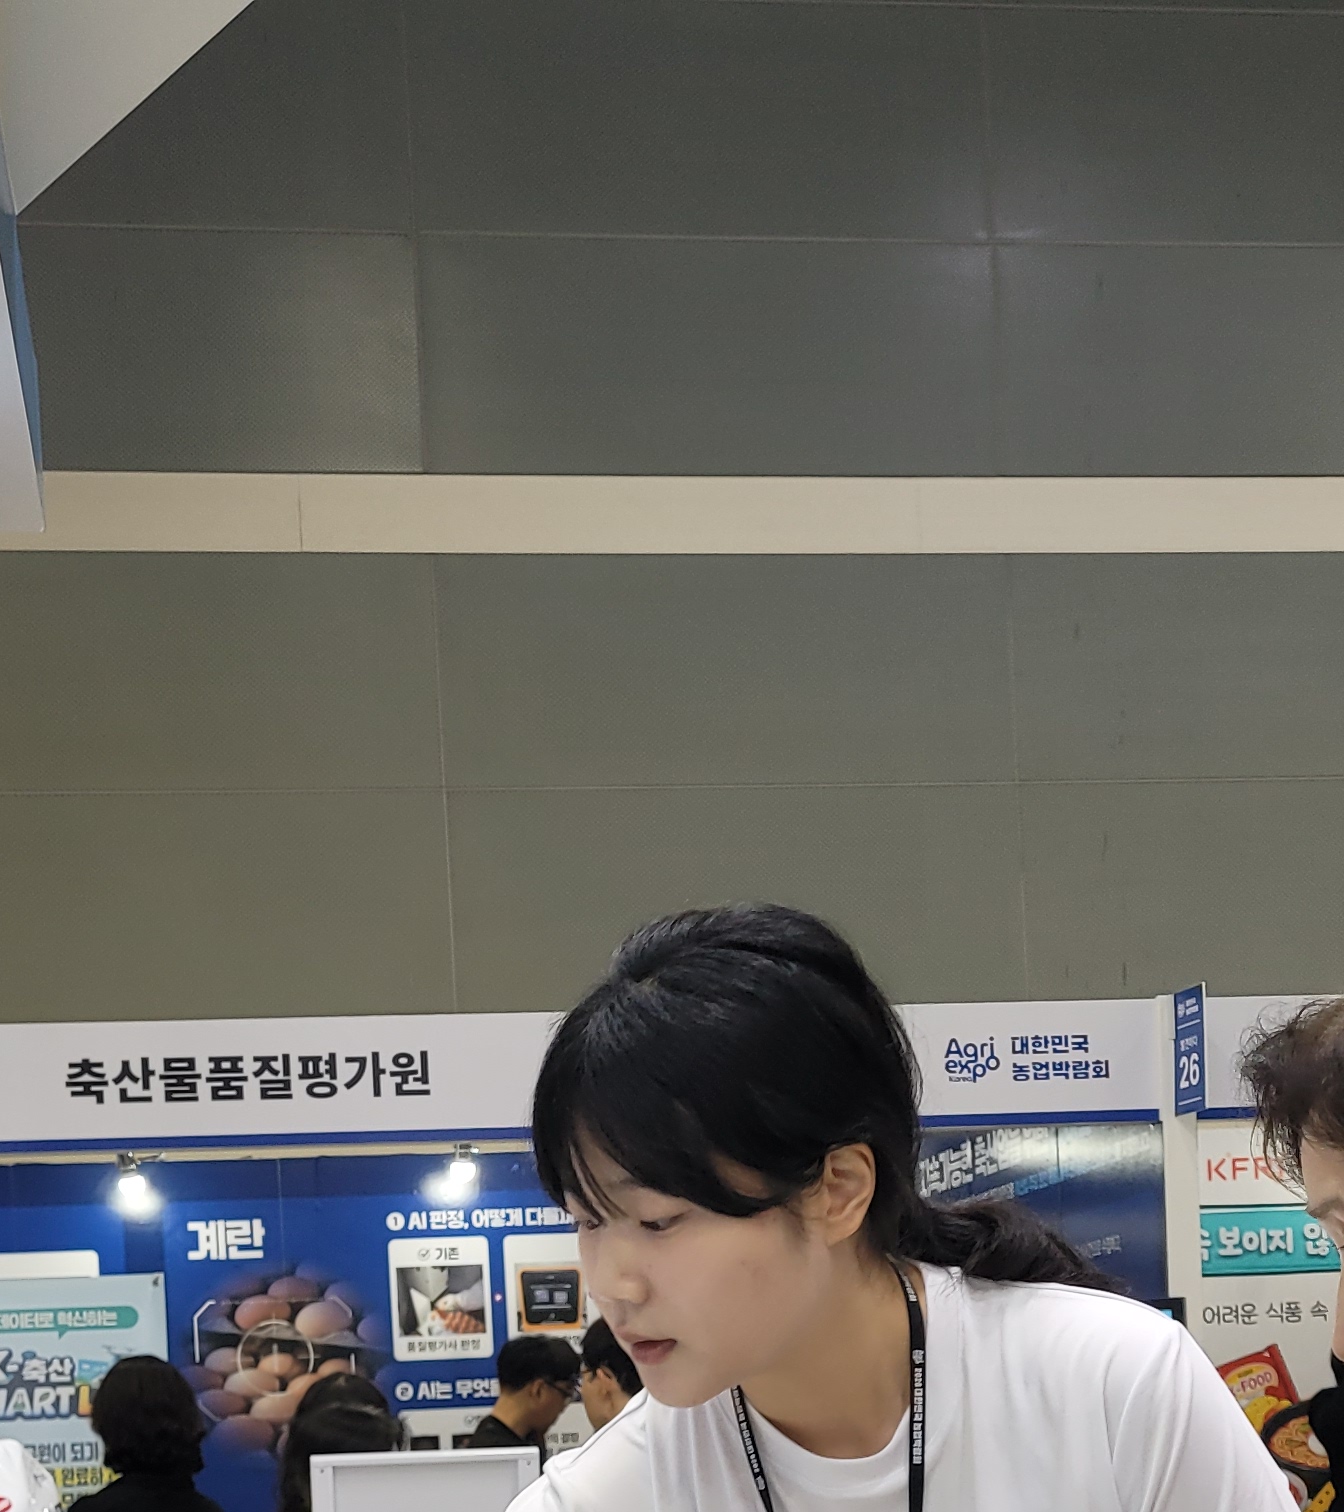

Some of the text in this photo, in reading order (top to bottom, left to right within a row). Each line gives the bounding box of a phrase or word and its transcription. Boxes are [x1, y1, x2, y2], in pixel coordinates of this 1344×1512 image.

[944, 1036, 997, 1064] Agri
[1011, 1034, 1090, 1055] 대한민국
[65, 1050, 431, 1103] 축산물품질평가원
[945, 1055, 1001, 1083] expo
[1012, 1059, 1111, 1082] 농업박람회
[1179, 1052, 1200, 1089] 26
[408, 1211, 427, 1230] AI
[429, 1209, 469, 1230] 판정,
[471, 1207, 523, 1228] 어떻게
[187, 1219, 265, 1260] 계란
[1218, 1225, 1294, 1257] 보이지
[435, 1247, 459, 1261] 기존
[57, 1309, 118, 1327] 혁신하는
[1203, 1300, 1329, 1325] 어려운 식품 속
[417, 1380, 453, 1399] AI는
[71, 1442, 98, 1461] 되기
